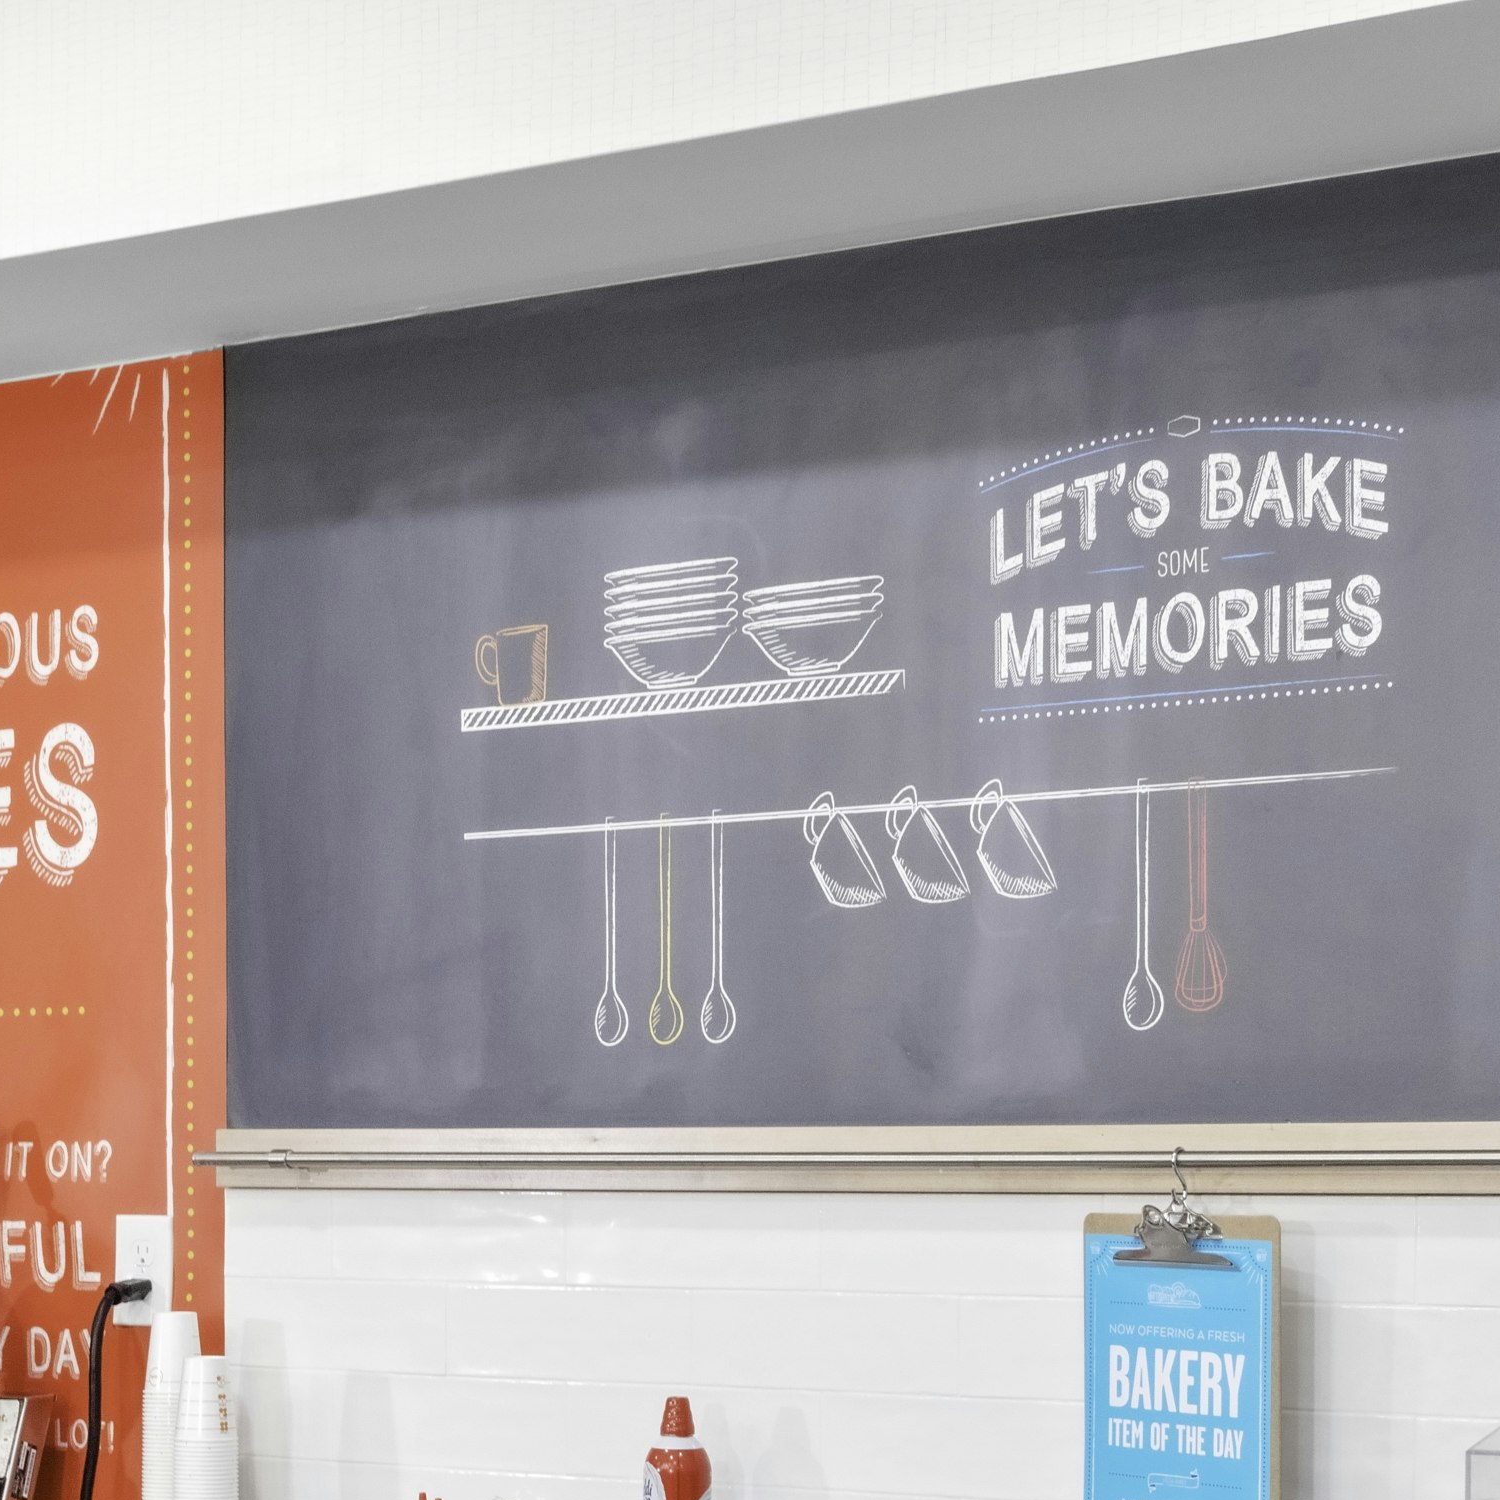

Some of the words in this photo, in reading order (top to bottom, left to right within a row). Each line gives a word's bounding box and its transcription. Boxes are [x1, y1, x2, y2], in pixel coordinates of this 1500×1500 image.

[990, 459, 1171, 586] LET'S
[1200, 451, 1389, 541] BAKE
[1156, 546, 1211, 578] SOME
[994, 574, 1383, 689] MEMORIES
[4, 1141, 34, 1183] IT
[45, 1139, 113, 1184] ON?
[1108, 1323, 1136, 1336] NOW
[1137, 1325, 1195, 1340] OFFERING
[1197, 1329, 1205, 1341] A
[1207, 1329, 1246, 1344] FRESH
[1108, 1343, 1246, 1419] BAKERY
[54, 1416, 115, 1455] LO!
[1107, 1416, 1144, 1450] ITEM
[1150, 1421, 1170, 1453] OF
[1175, 1423, 1207, 1457] THE
[1212, 1427, 1244, 1461] DAY
